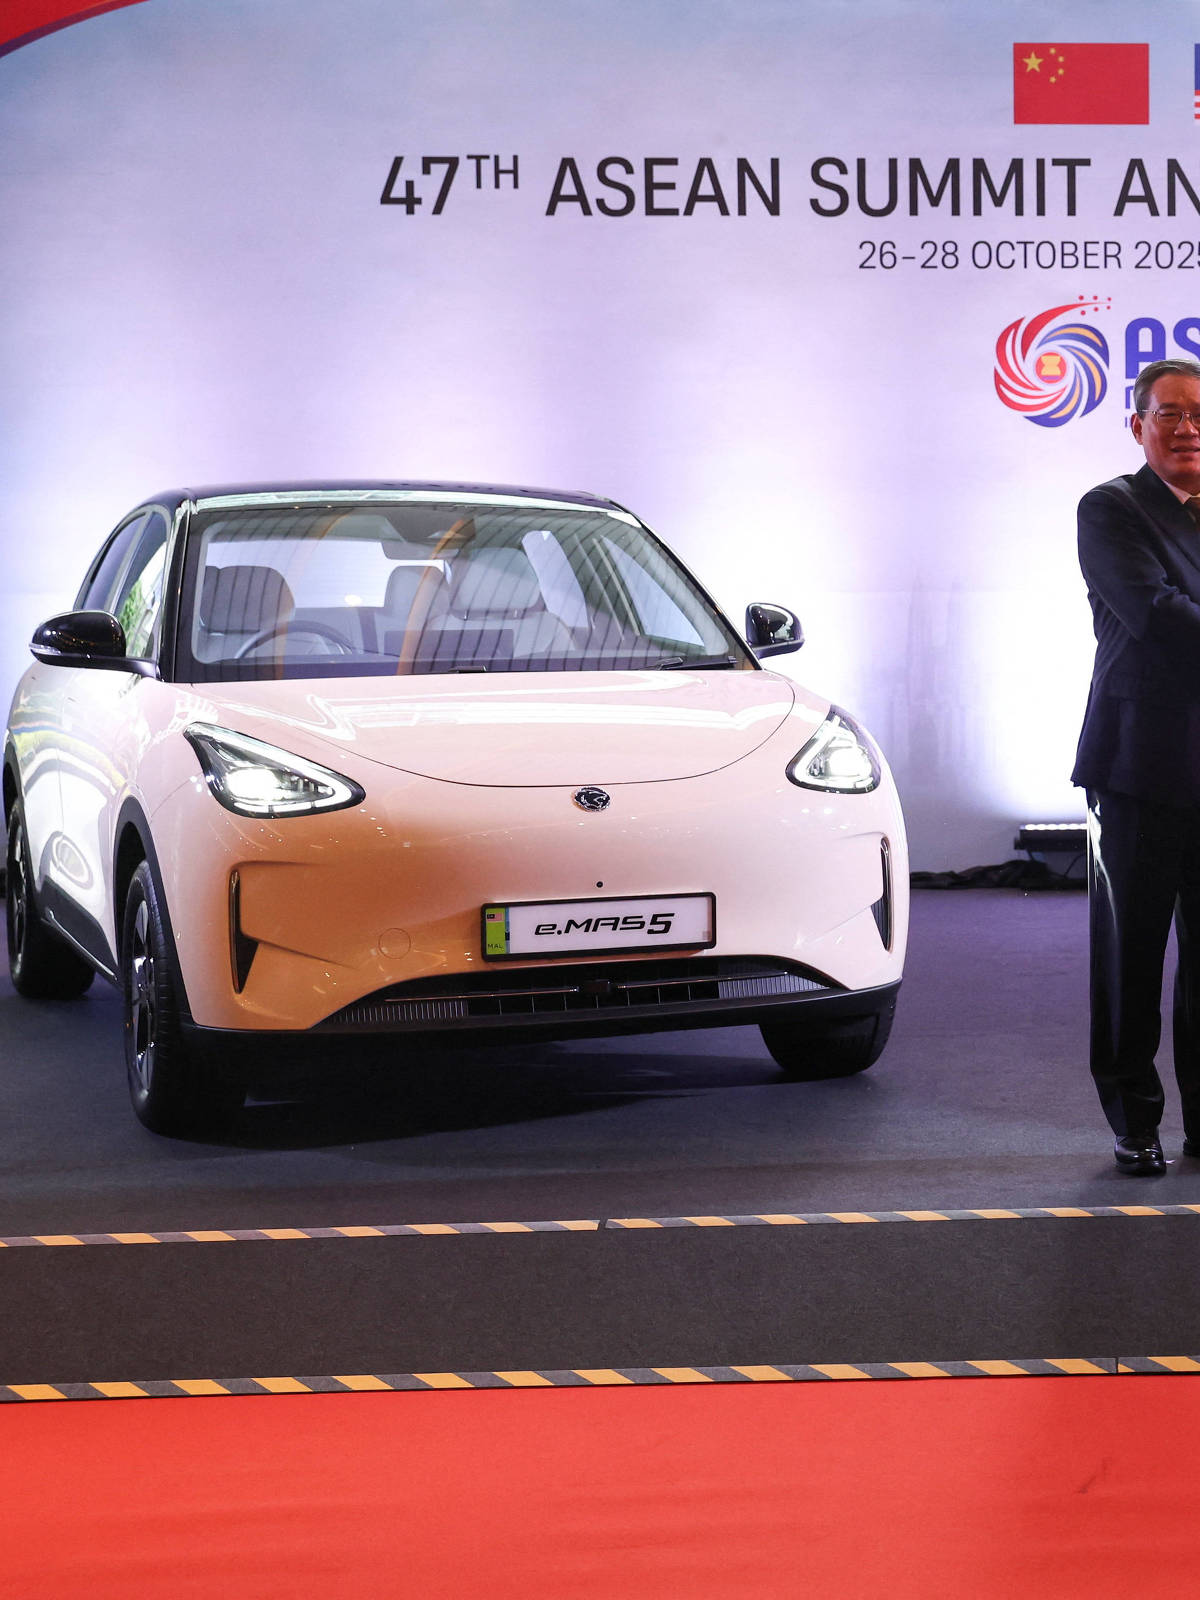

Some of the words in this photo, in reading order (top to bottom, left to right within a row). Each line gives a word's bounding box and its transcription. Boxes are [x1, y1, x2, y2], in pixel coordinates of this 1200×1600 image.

[379, 154, 519, 216] 47TH
[545, 156, 780, 218] ASEAN
[809, 156, 1092, 218] SUMMIT
[971, 240, 1122, 270] OCTOBER
